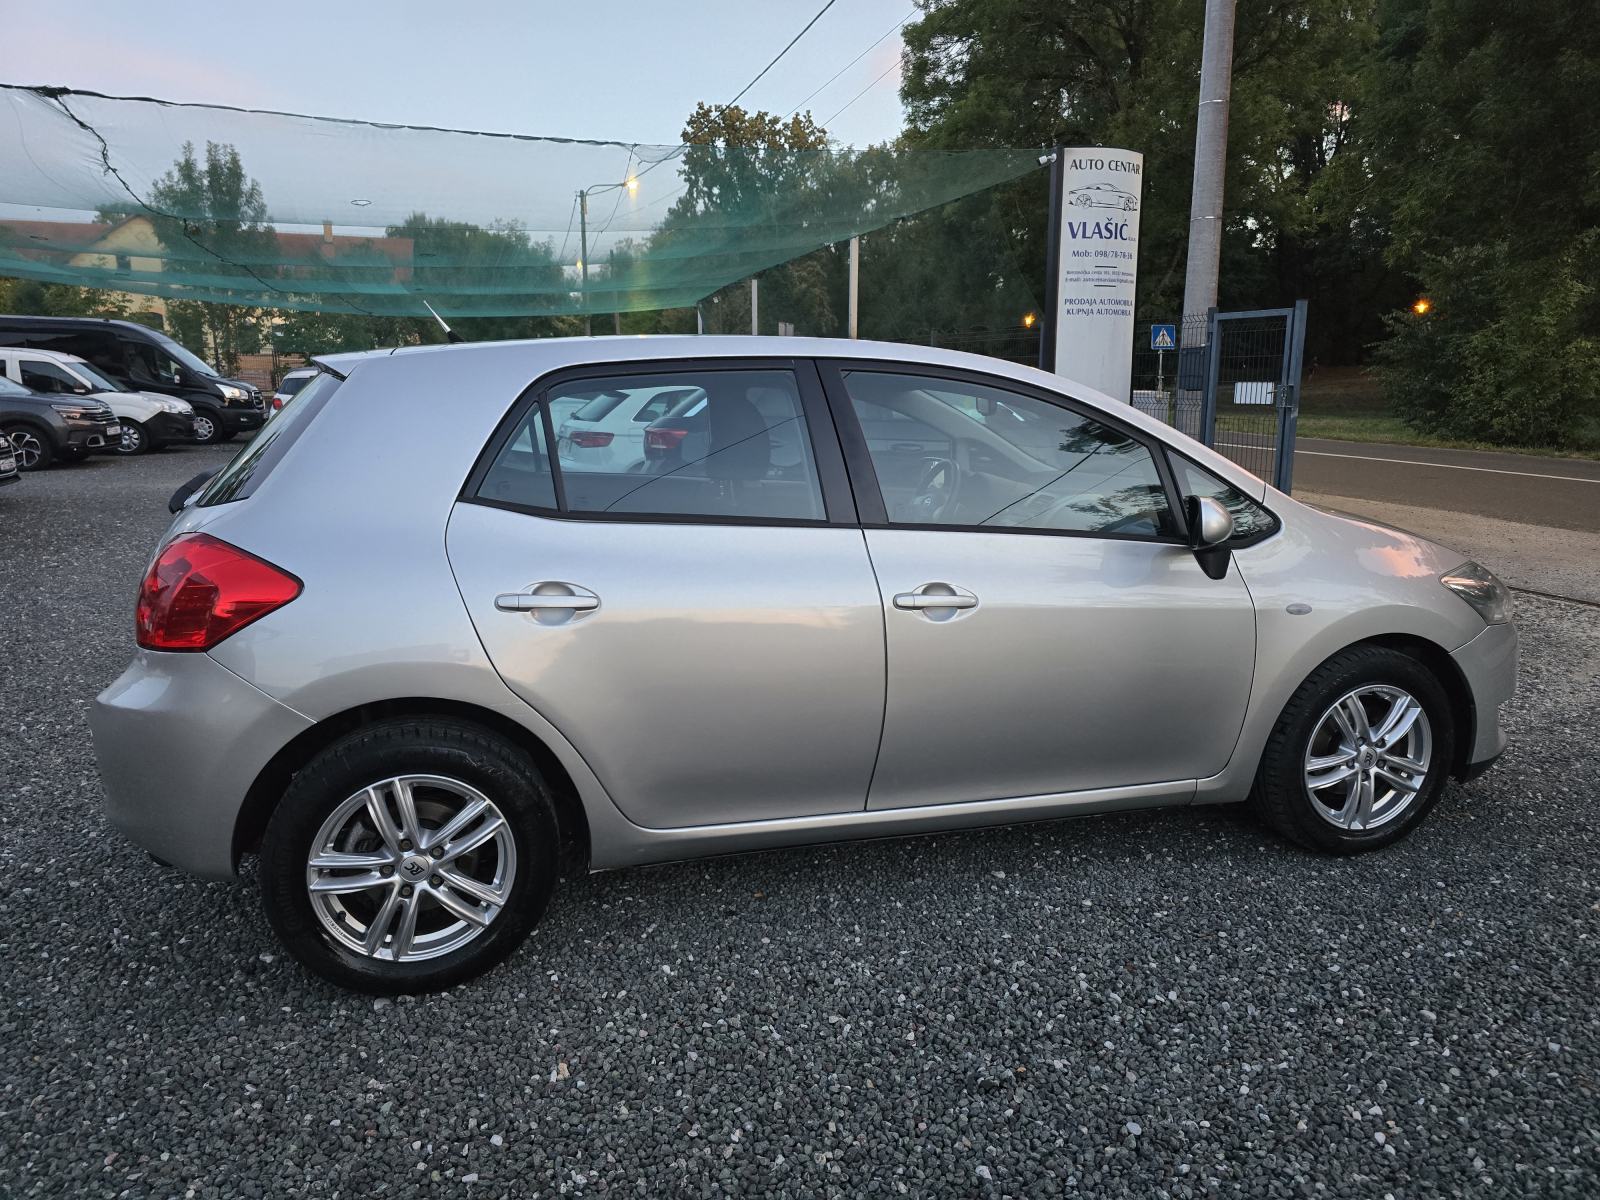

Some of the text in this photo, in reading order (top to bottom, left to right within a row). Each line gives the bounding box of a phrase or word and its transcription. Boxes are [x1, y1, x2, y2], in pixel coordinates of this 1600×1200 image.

[1069, 159, 1141, 175] AUTO CENTAR
[1067, 217, 1129, 241] VLAŠIĆ
[1071, 250, 1092, 258] Mob:
[1064, 298, 1133, 307] PRODAJA AUTOMOBILA
[1066, 308, 1131, 317] KUPNJA AUTOMOBILA
